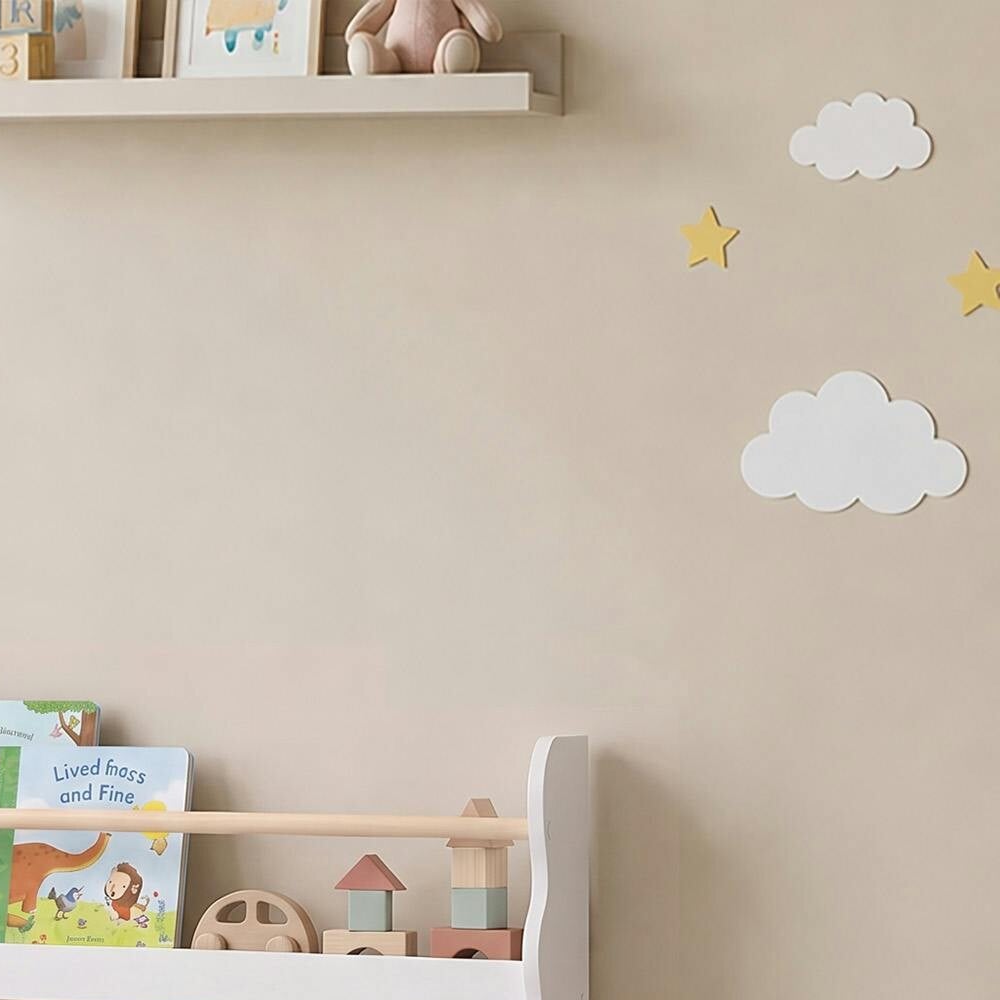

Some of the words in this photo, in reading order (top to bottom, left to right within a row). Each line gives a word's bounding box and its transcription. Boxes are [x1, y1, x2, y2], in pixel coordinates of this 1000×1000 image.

[10, 0, 35, 24] R
[52, 757, 102, 782] Lived
[59, 782, 93, 804] and
[98, 783, 135, 805] Fine
